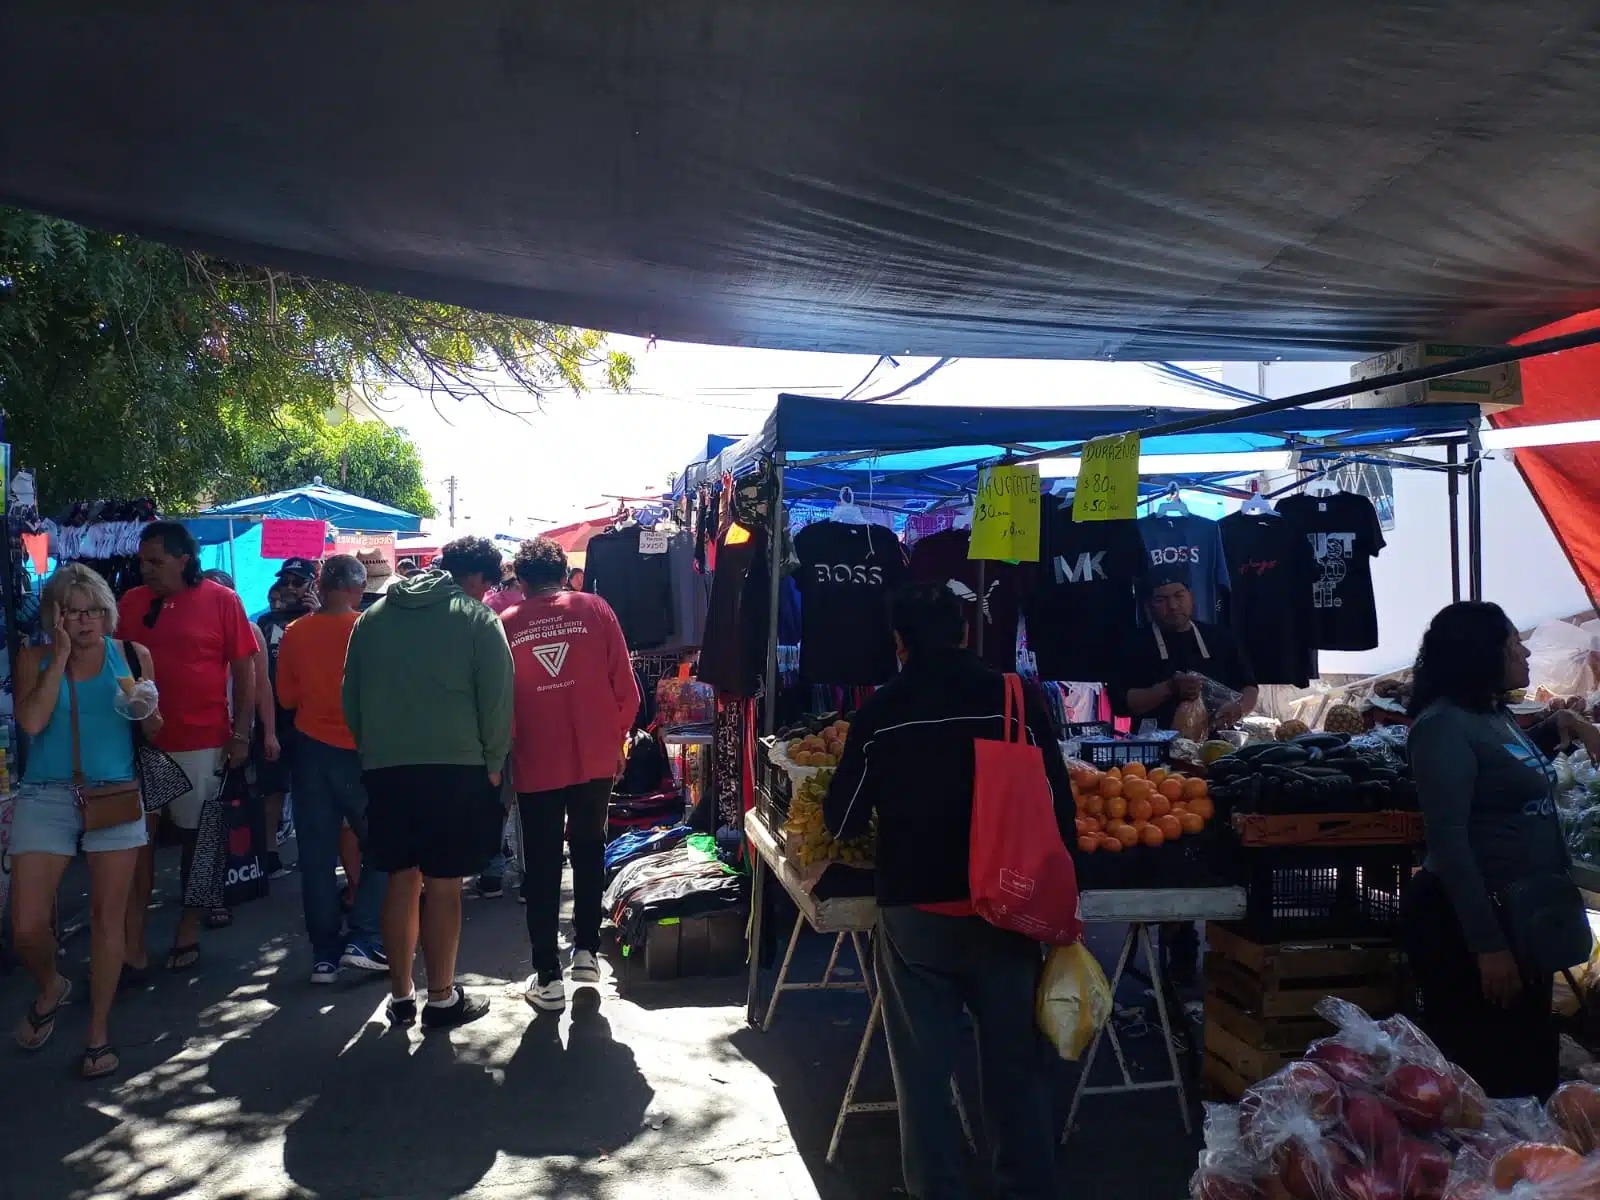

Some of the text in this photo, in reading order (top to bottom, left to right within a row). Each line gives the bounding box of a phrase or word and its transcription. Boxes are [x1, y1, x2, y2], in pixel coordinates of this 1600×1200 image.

[1151, 545, 1201, 566] BOSS
[814, 563, 883, 585] BOSS
[1053, 550, 1109, 585] MK
[511, 632, 541, 648] AHORRO
[541, 630, 558, 638] QUE
[567, 626, 588, 634] NOTA
[225, 855, 264, 886] ocal.
